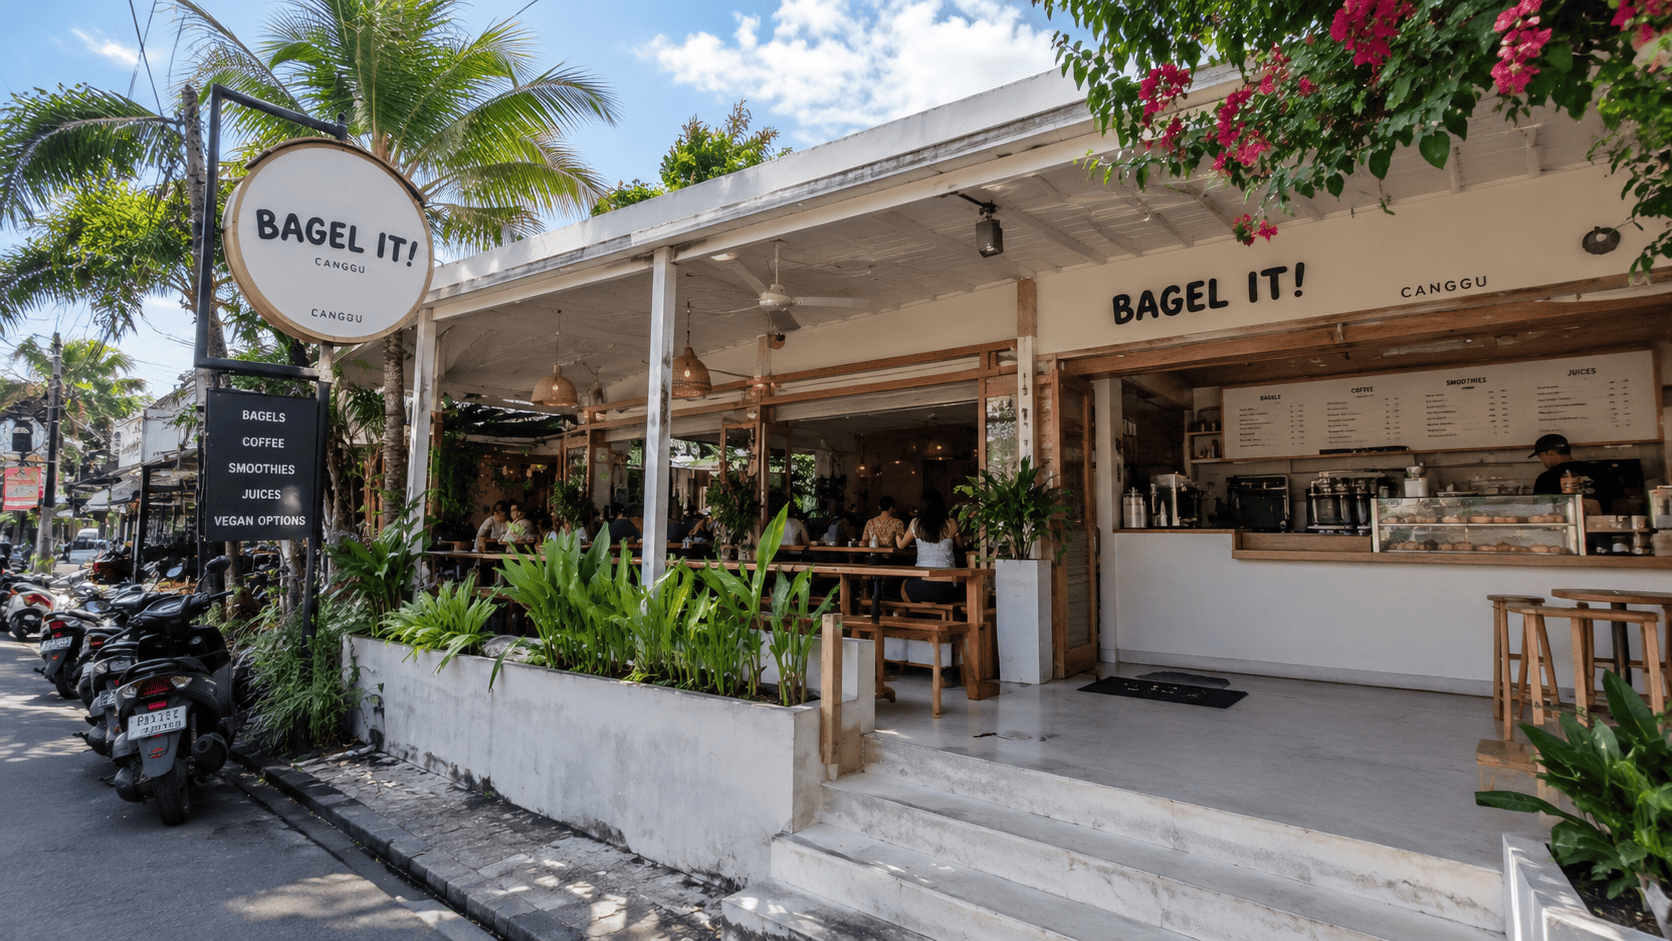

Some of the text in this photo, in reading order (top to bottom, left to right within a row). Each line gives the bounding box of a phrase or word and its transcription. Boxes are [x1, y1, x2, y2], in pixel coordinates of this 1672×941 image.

[256, 209, 418, 267] BAGEL IT!
[314, 257, 365, 274] CANGGU
[1400, 275, 1488, 298] CANGGU
[1111, 262, 1305, 325] BAGEL IT!
[311, 308, 363, 323] CANGGU
[1567, 367, 1597, 376] JUICES
[1445, 377, 1487, 385] SMOOTHIES
[242, 410, 286, 423] BAGELS
[242, 437, 285, 448] COFFEE
[228, 462, 296, 475] SMOOTHIES
[241, 489, 282, 500] JUICES
[214, 515, 306, 526] VEGAN OPTIONS
